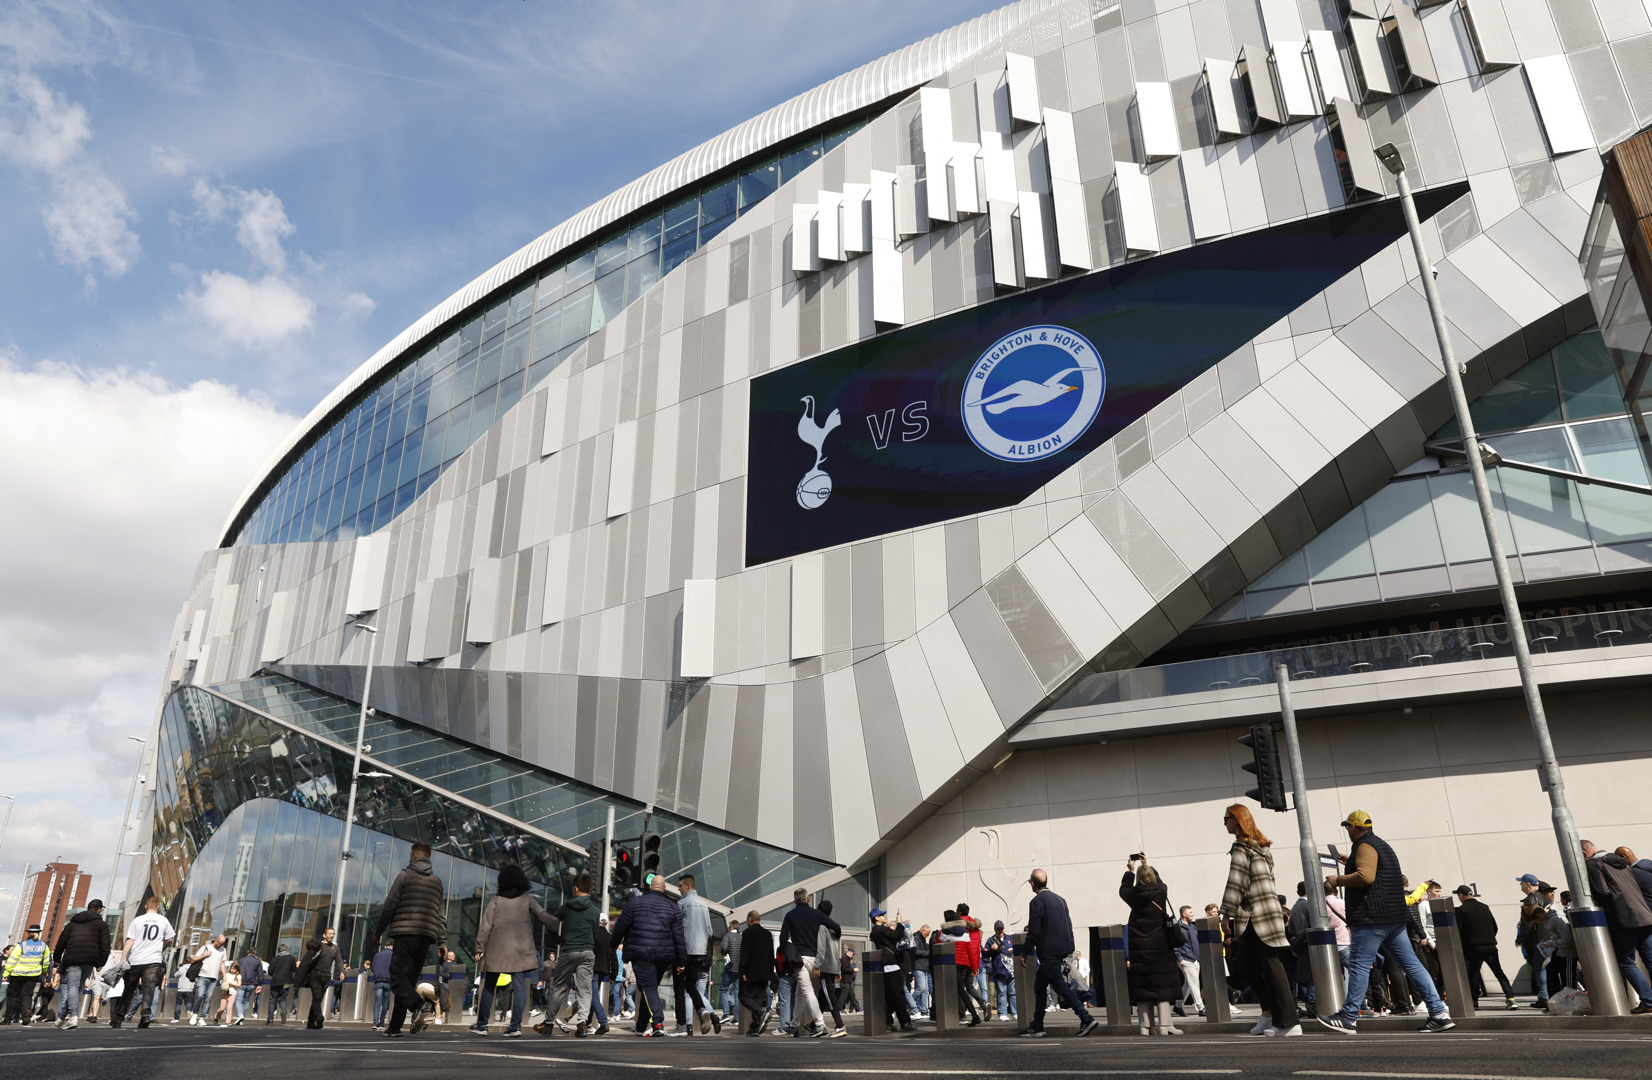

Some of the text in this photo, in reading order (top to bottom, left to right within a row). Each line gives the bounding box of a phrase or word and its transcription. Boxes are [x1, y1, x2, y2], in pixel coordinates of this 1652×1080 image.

[975, 331, 1085, 380] BRIGHTON & HOVE
[866, 400, 930, 450] VS
[1007, 434, 1063, 456] ALBION
[142, 923, 159, 941] 10
